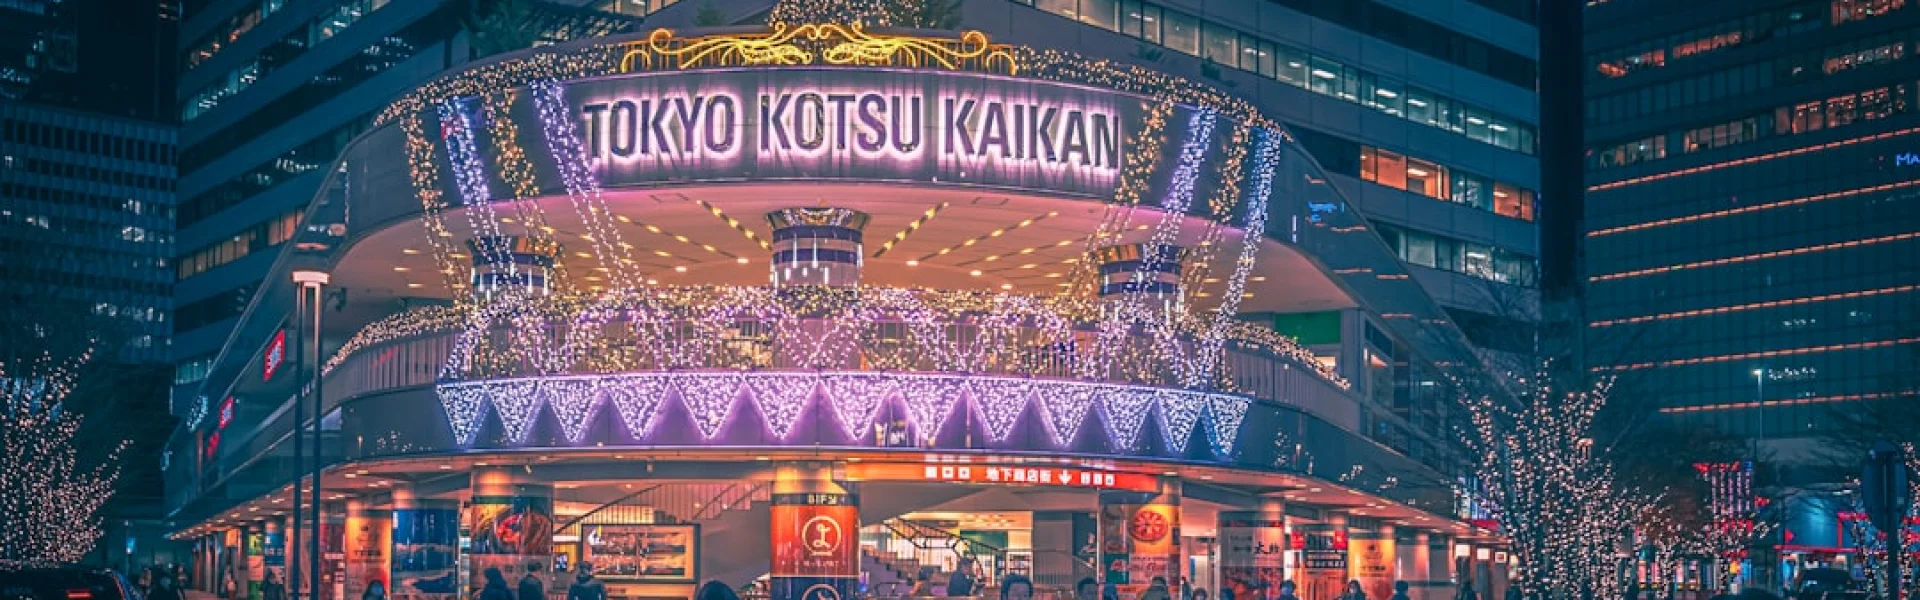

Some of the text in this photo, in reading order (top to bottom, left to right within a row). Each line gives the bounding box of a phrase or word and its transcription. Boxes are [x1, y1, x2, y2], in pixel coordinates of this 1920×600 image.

[582, 92, 1119, 169] TOKYO KOTSU KAIKAN
